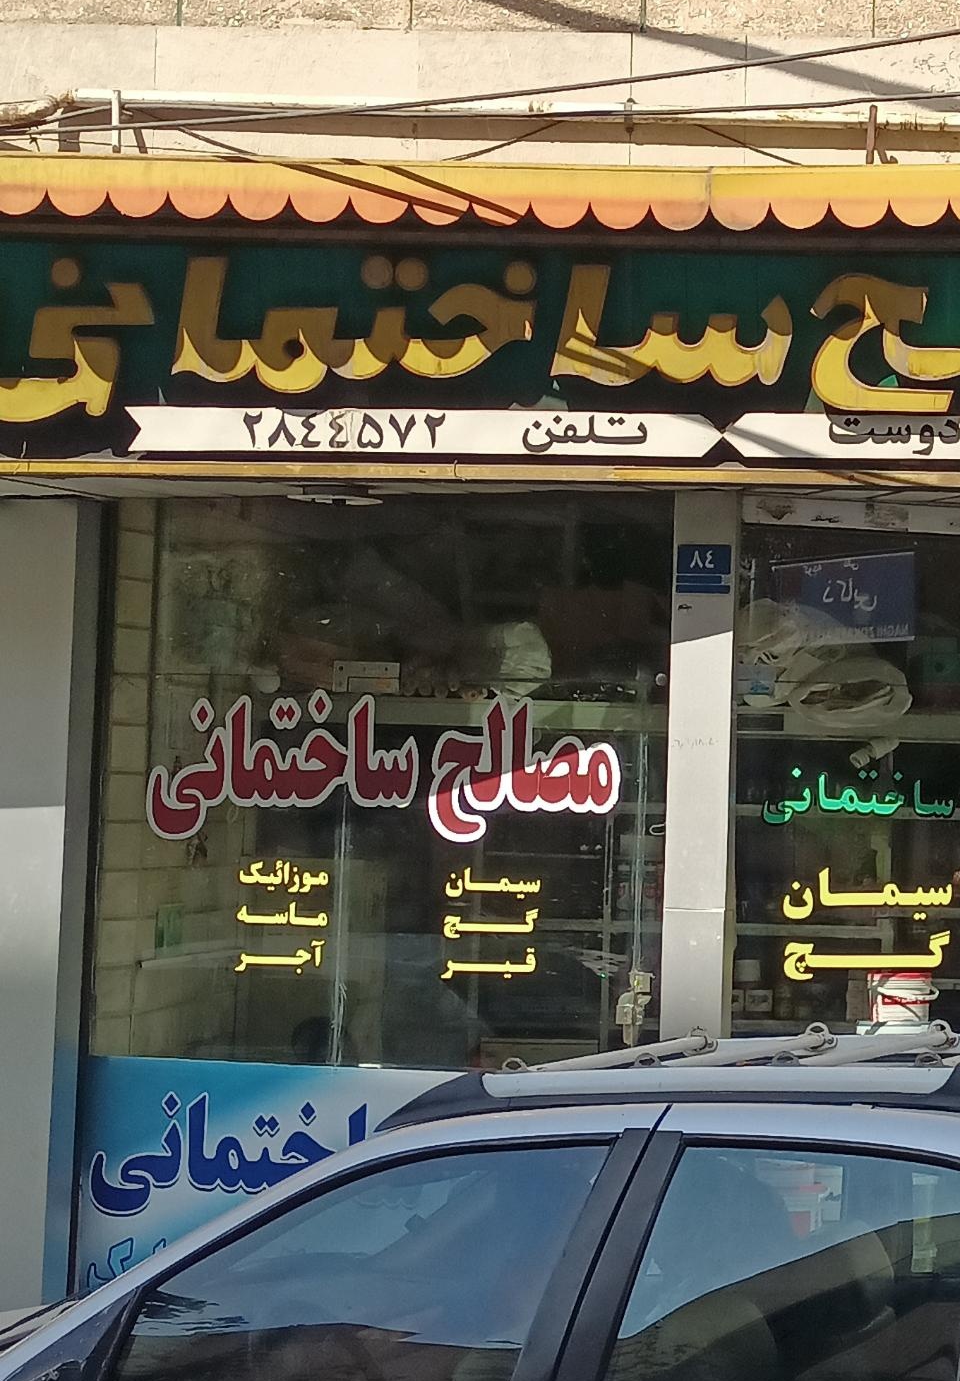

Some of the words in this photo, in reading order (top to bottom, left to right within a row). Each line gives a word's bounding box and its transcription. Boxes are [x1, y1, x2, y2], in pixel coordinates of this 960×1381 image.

[0, 255, 793, 422] ساختمانی
[522, 415, 648, 453] تلفن
[147, 688, 419, 840] ساختمانی
[427, 694, 622, 843] مصالح
[763, 767, 954, 824] ساختمانی
[445, 867, 541, 899] سیمان
[782, 867, 953, 920] سیمان
[236, 901, 328, 927] ماسه
[443, 908, 539, 939] گچ
[234, 940, 326, 974] آجر
[440, 947, 537, 979] قیر
[783, 930, 951, 981] گچ
[90, 1091, 367, 1216] ختمانی
